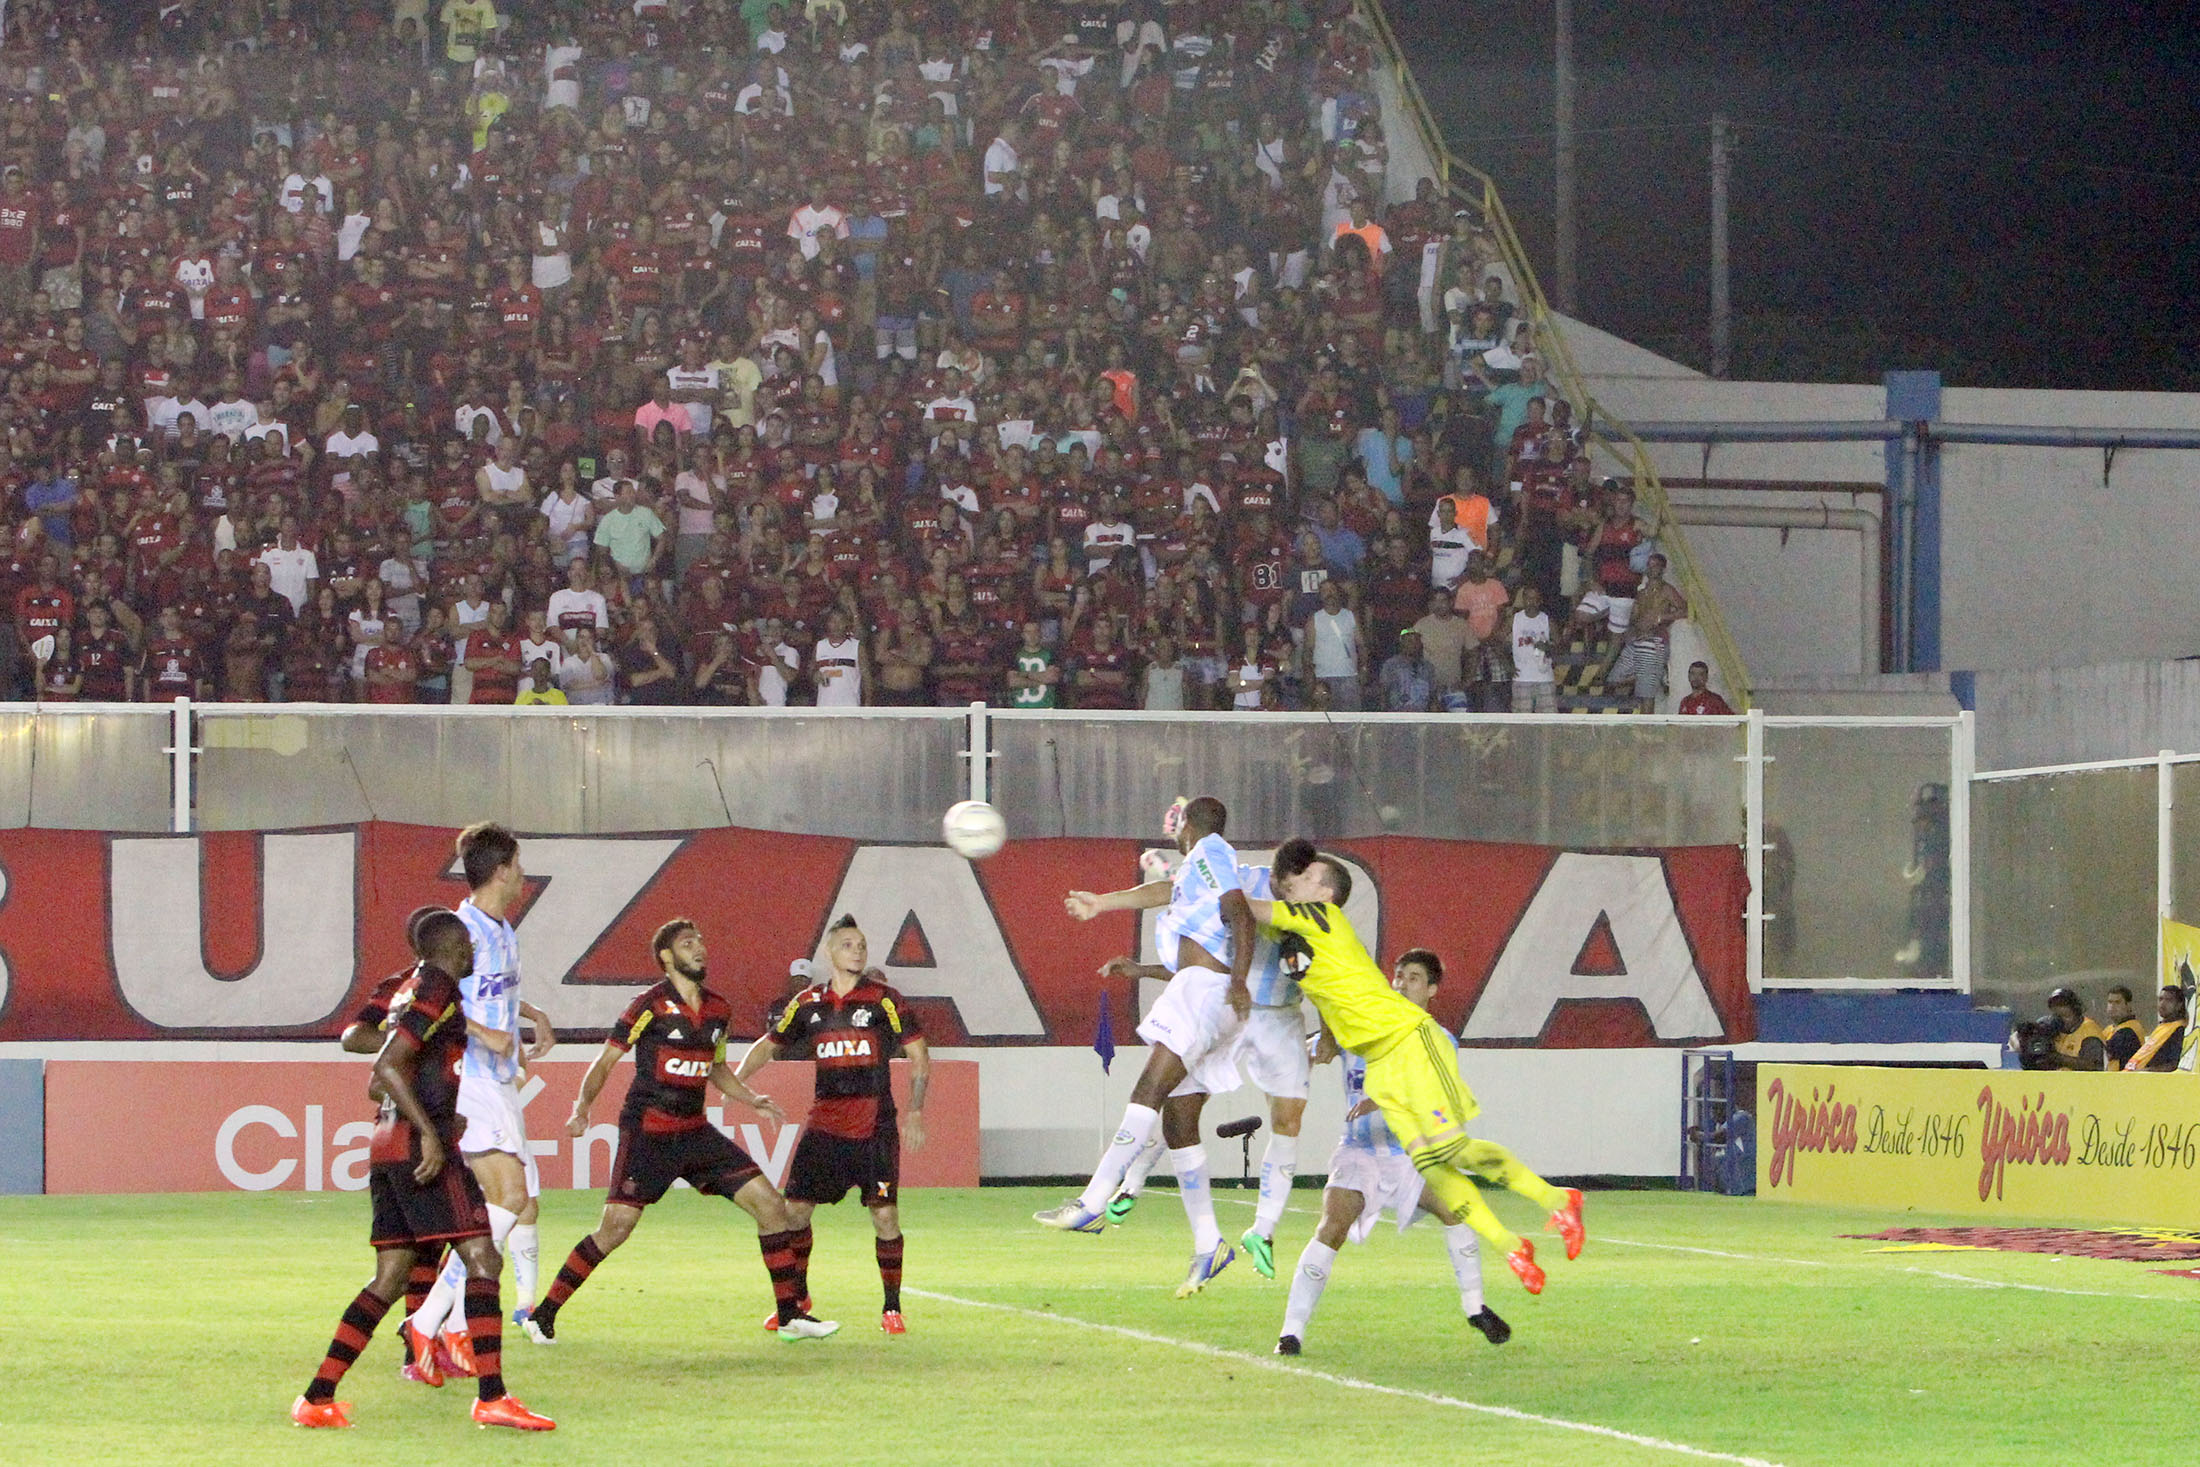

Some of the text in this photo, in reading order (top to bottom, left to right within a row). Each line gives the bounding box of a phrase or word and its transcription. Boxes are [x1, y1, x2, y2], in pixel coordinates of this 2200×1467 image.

[1243, 496, 1272, 506] CAIXA
[29, 617, 58, 627] CAIXA
[1196, 858, 1219, 889] MRV
[816, 1040, 871, 1059] CAIXA
[665, 1057, 712, 1078] CAIX
[1768, 1077, 1970, 1188] Ypióca Desde 1846
[1977, 1085, 2200, 1202] Ypióca Desde 1846
